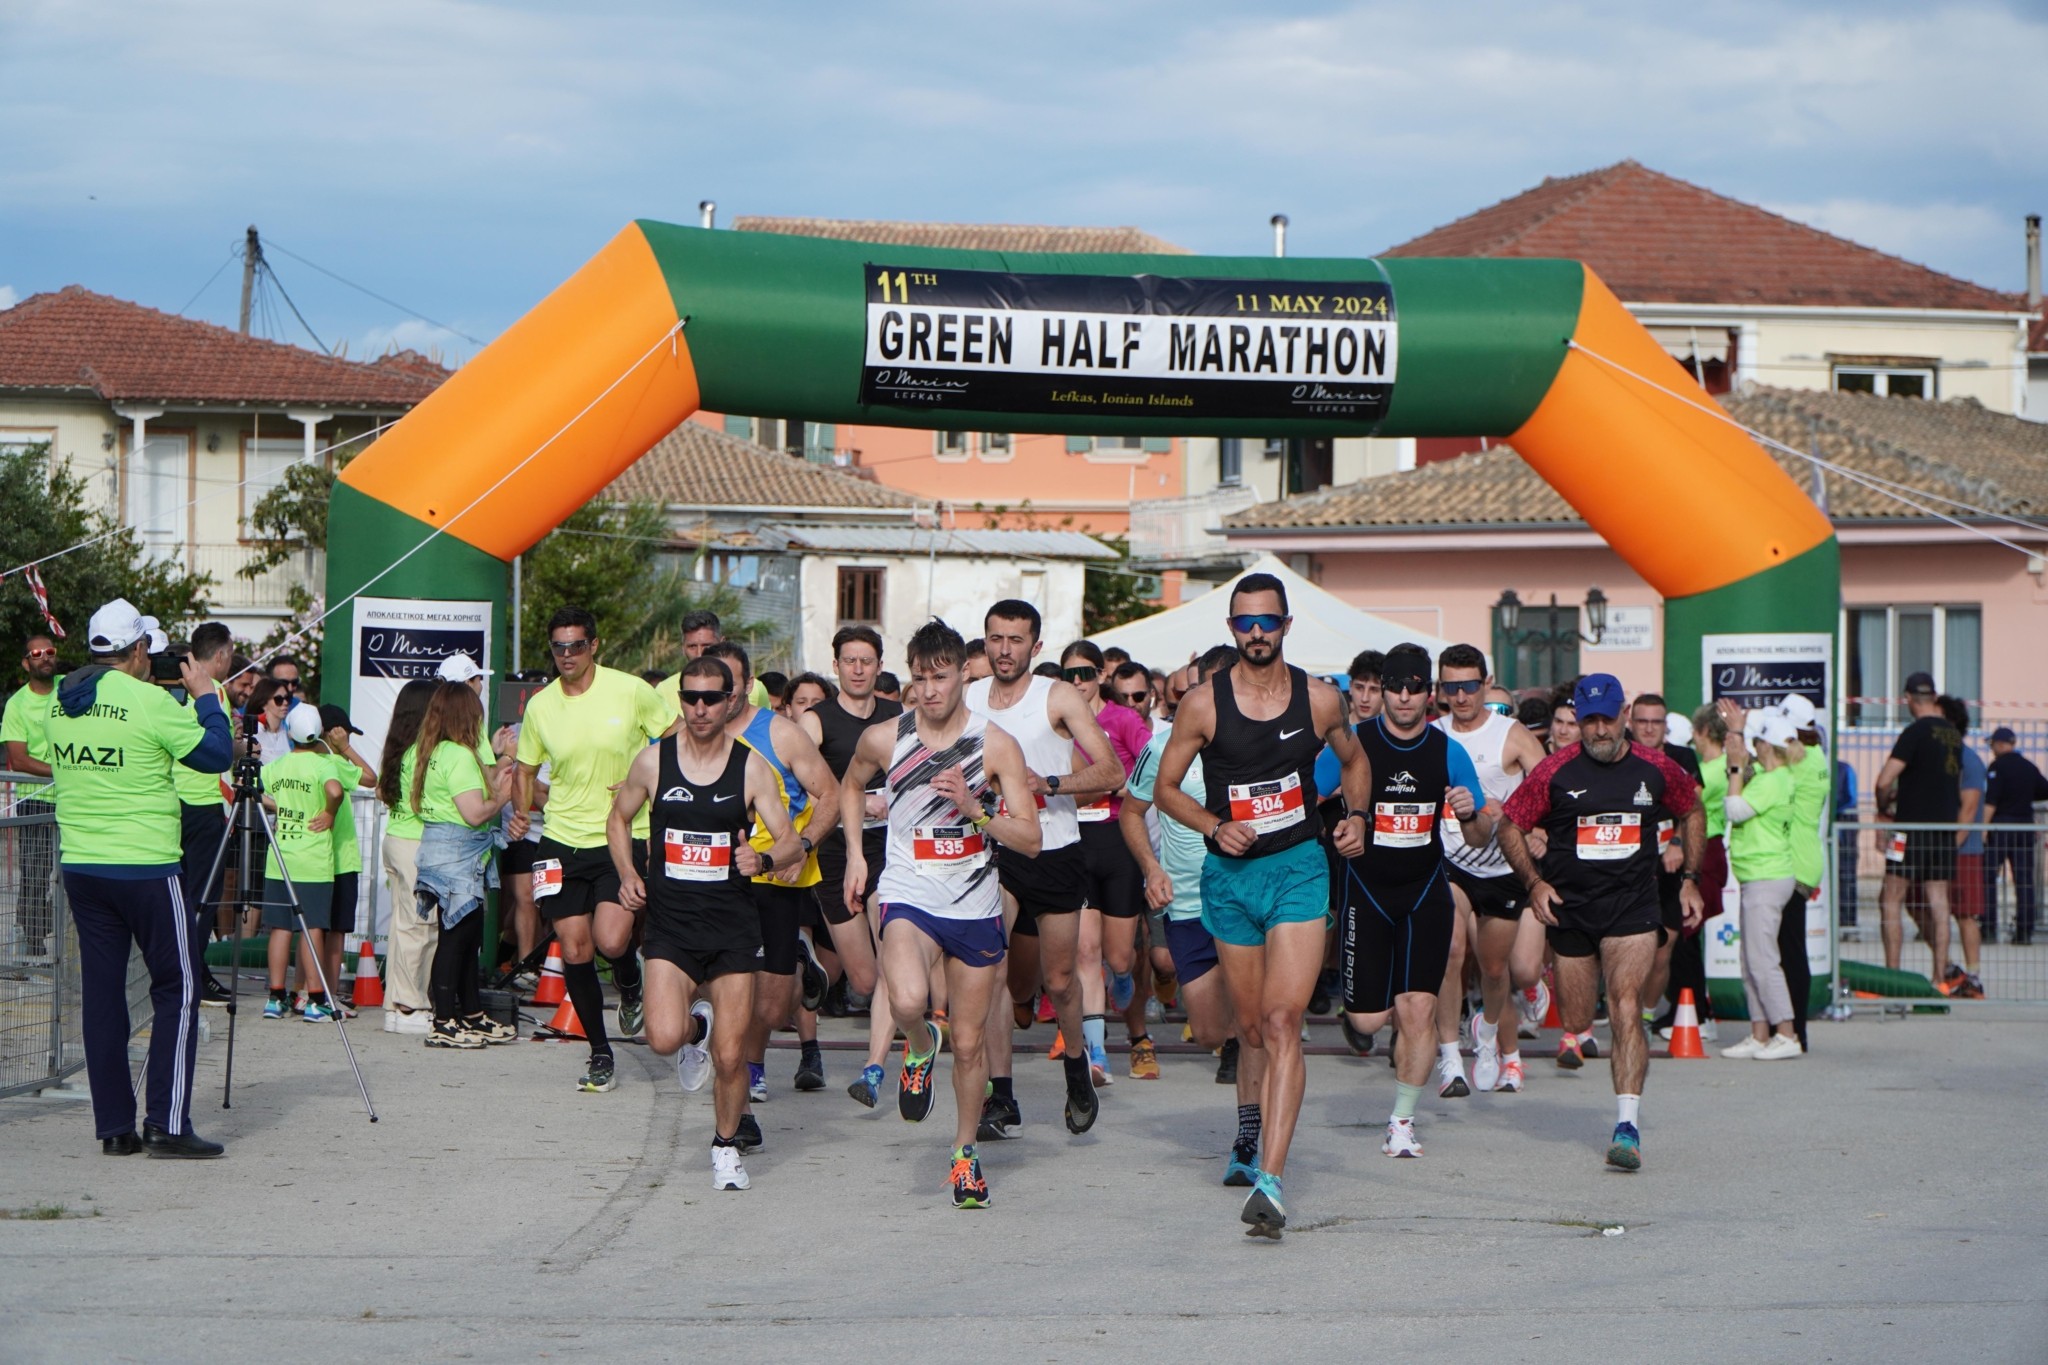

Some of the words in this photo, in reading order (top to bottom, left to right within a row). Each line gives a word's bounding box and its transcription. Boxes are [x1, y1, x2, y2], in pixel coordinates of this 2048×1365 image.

[1236, 294, 1261, 312] 11
[1269, 294, 1325, 313] MAY
[1333, 296, 1389, 316] 2024
[879, 310, 1013, 365] GREEN
[1041, 318, 1142, 369] HALF
[1168, 323, 1387, 376] MARATHON
[895, 370, 969, 388] Marin
[895, 391, 943, 401] LEFKAS
[1051, 391, 1097, 404] Lefkas,
[1102, 392, 1144, 405] Ionian
[1148, 394, 1195, 406] Islands
[1310, 383, 1382, 400] Marin
[1309, 405, 1356, 413] LEFKAS
[367, 611, 425, 620] ΑΠΟΚΛΕΙΣΤΙΚΟΣ
[453, 614, 482, 622] ΧΟΡΗΓΟΣ
[391, 632, 479, 656] Marin
[392, 665, 441, 676] LEFKA
[1742, 665, 1821, 687] Marin
[51, 704, 129, 722] ΕΘΟΝΤΗΣ
[63, 765, 121, 773] RESTAURANT
[1385, 784, 1416, 794] sailfish
[1252, 795, 1284, 815] 304
[278, 807, 304, 820] Piaa
[1393, 816, 1419, 830] 318
[1595, 826, 1622, 841] 459
[681, 845, 712, 862] 370
[934, 840, 965, 856] 535
[533, 871, 547, 884] 03
